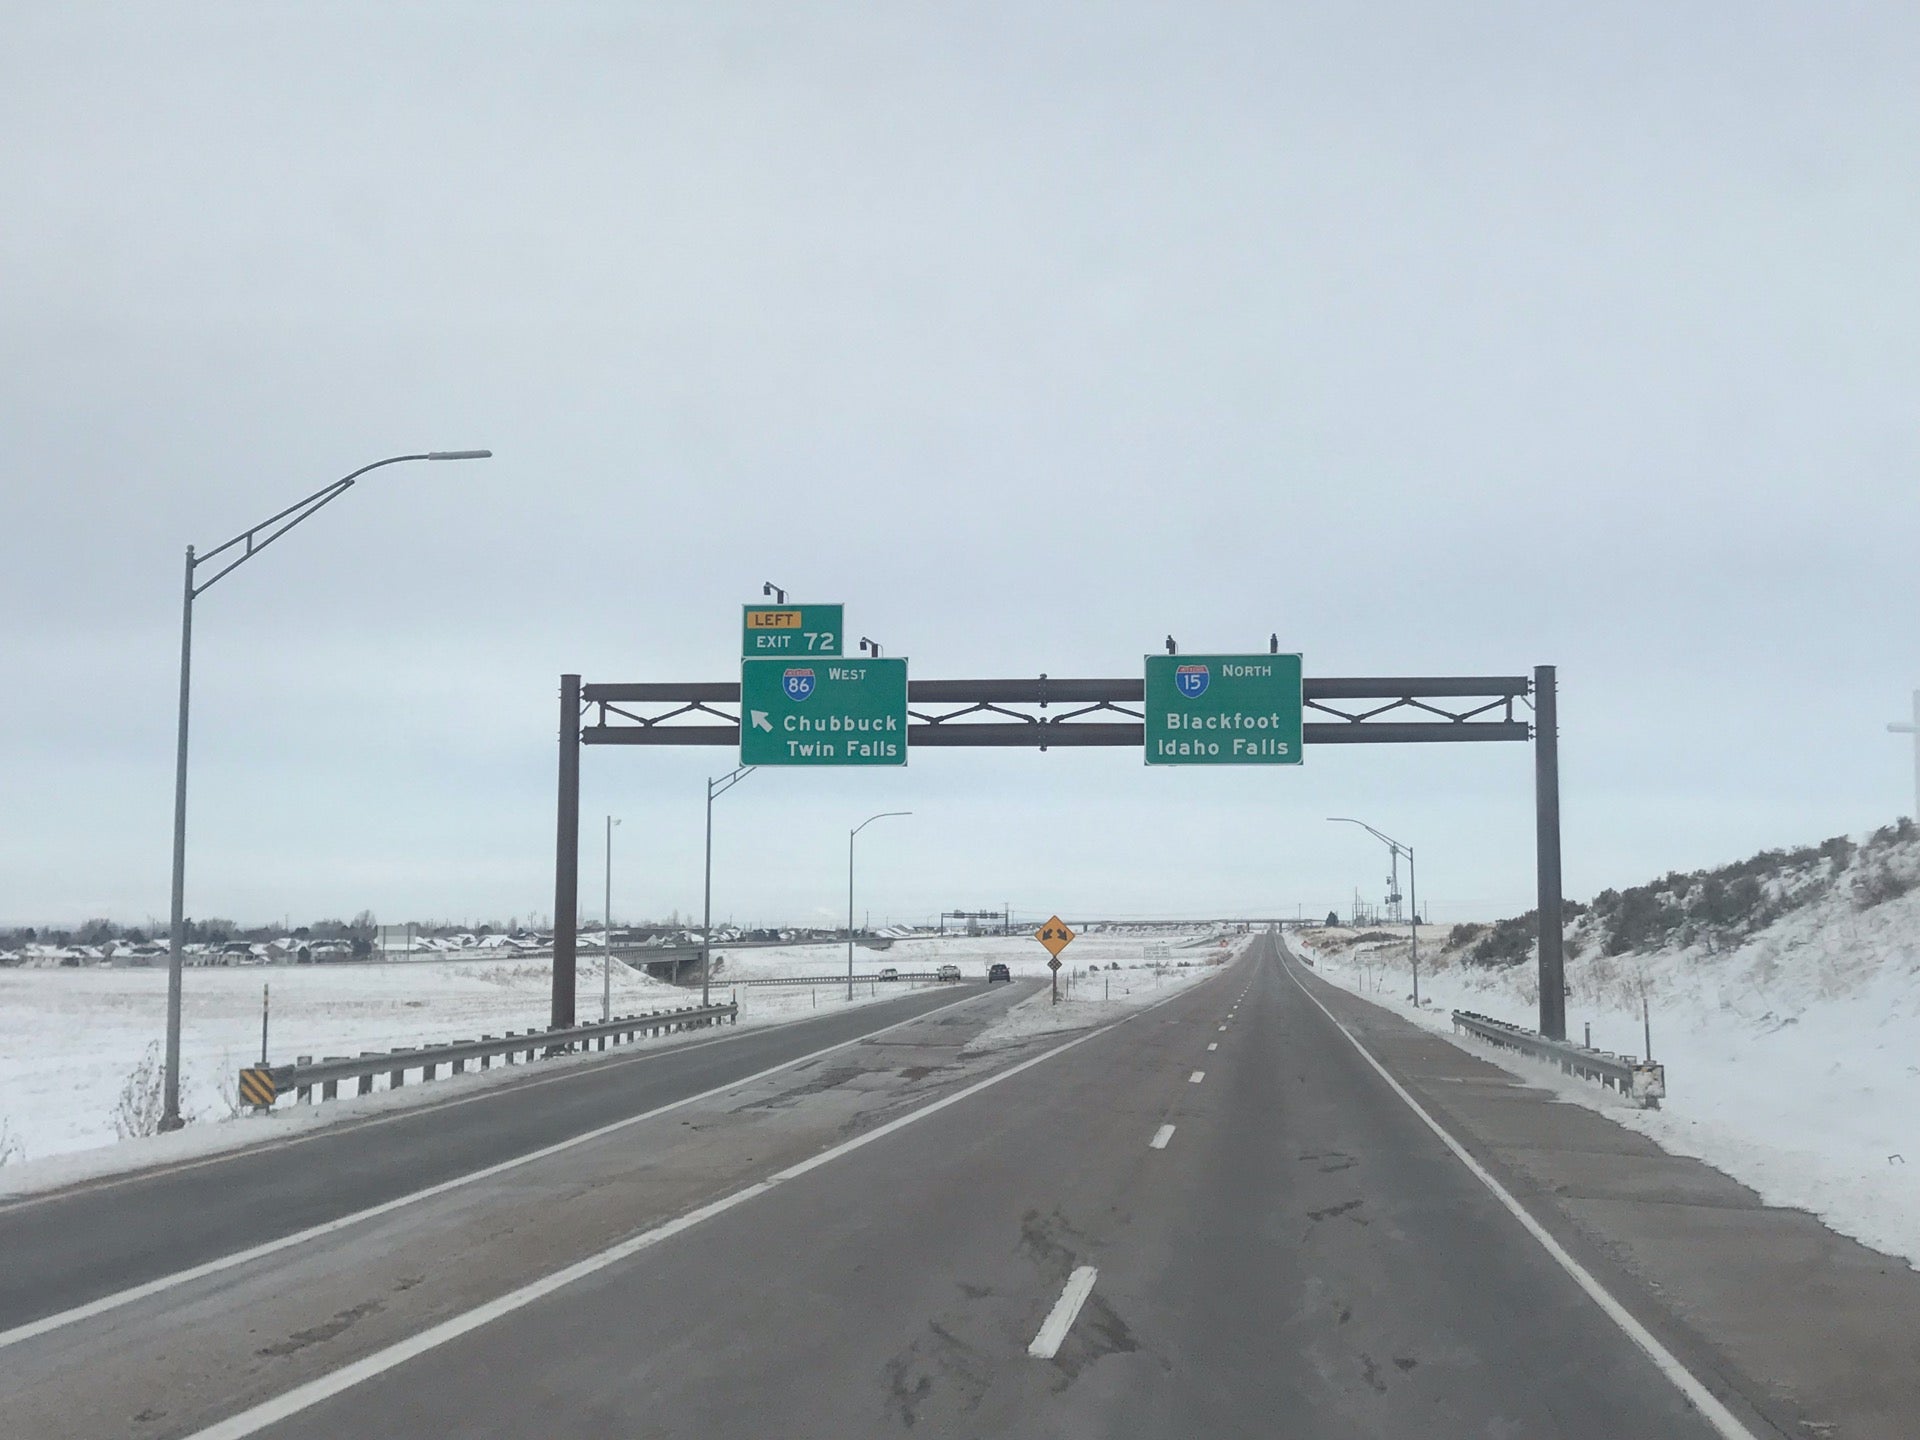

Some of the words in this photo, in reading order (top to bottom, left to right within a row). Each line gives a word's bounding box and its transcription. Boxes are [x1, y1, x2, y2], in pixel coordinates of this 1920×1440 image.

[756, 614, 793, 626] LEFT
[757, 636, 791, 648] EXIT
[803, 632, 834, 650] 72
[829, 668, 866, 680] WEST
[1222, 664, 1271, 677] NORTH
[788, 678, 810, 693] 86
[1184, 674, 1201, 690] 15
[783, 715, 897, 731] Chubbuck
[1167, 713, 1280, 730] Blackfoot
[787, 741, 834, 756] Twin
[847, 740, 897, 756] Falls
[1158, 739, 1220, 755] Idaho
[1233, 738, 1289, 755] Falls
